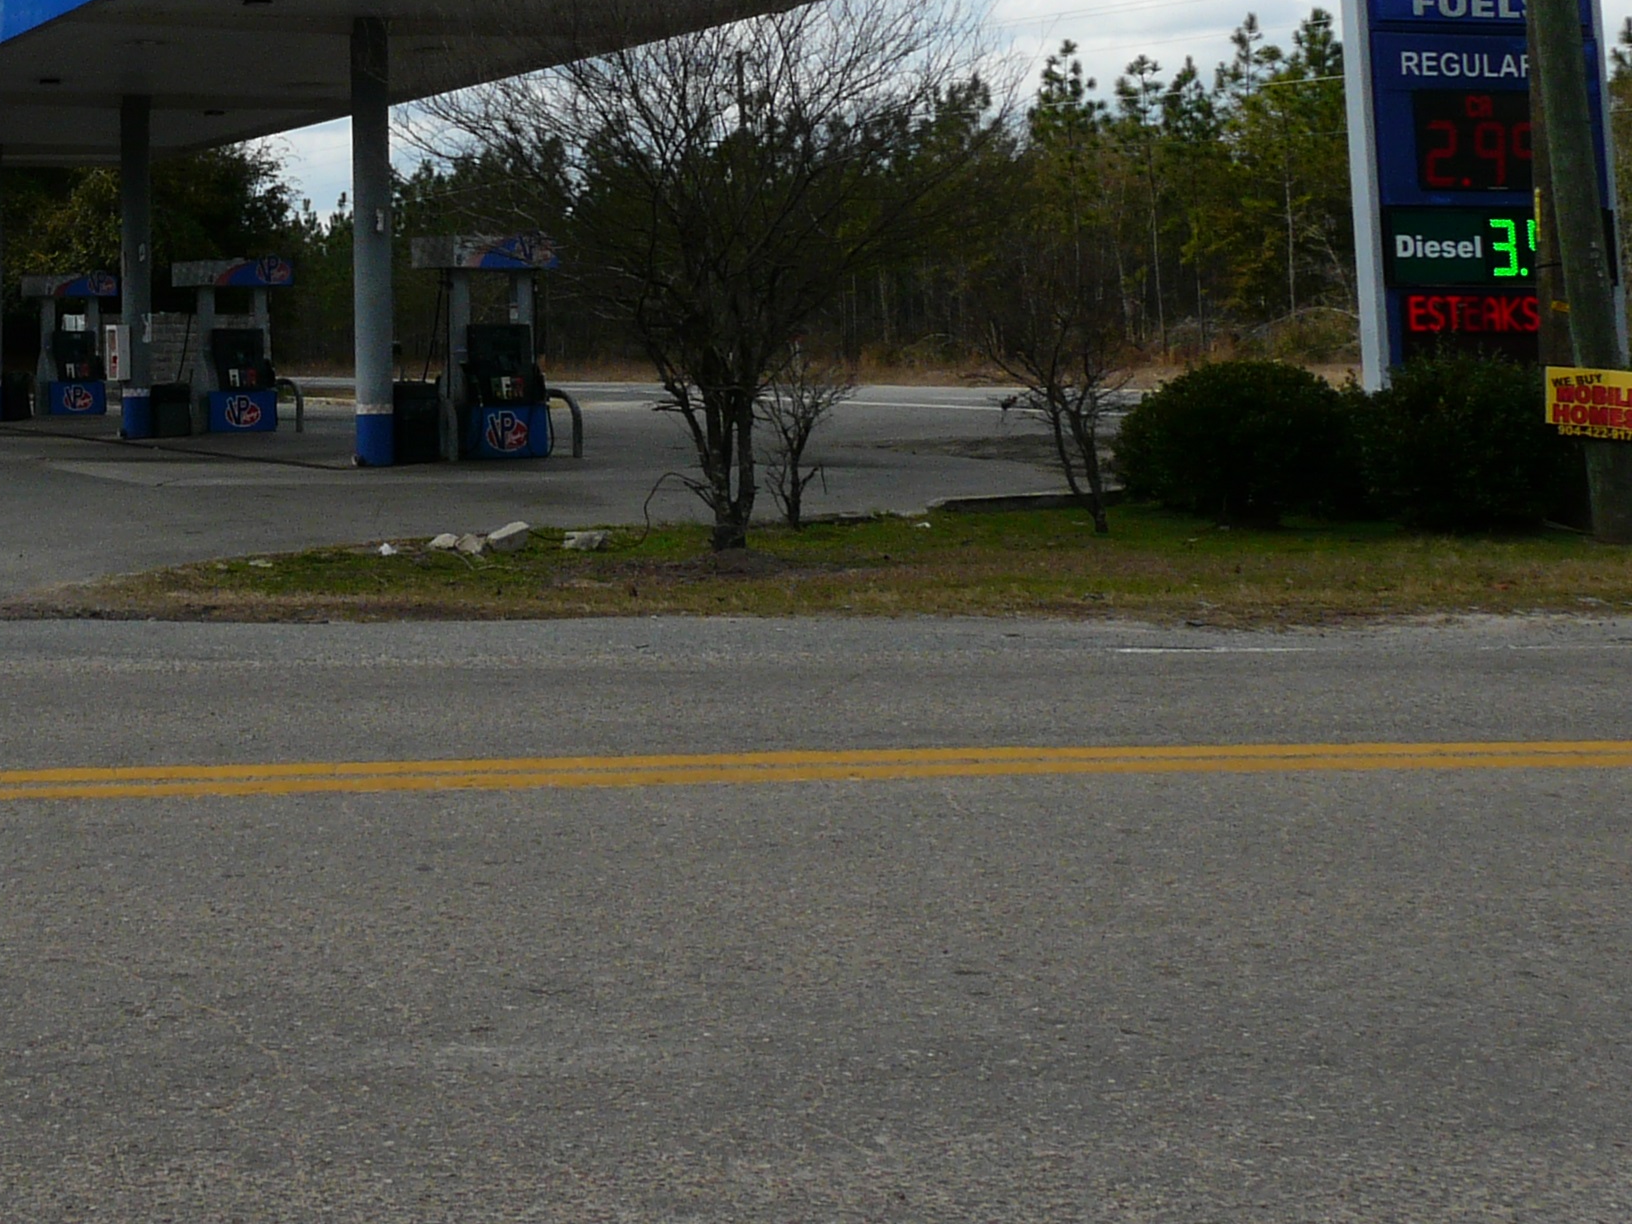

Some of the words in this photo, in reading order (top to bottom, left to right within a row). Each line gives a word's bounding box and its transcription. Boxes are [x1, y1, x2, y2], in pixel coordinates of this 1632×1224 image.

[1395, 235, 1483, 259] Diesel
[1551, 376, 1572, 387] WE
[1575, 373, 1602, 385] BUY
[226, 395, 252, 425] VP
[487, 410, 517, 450] VP
